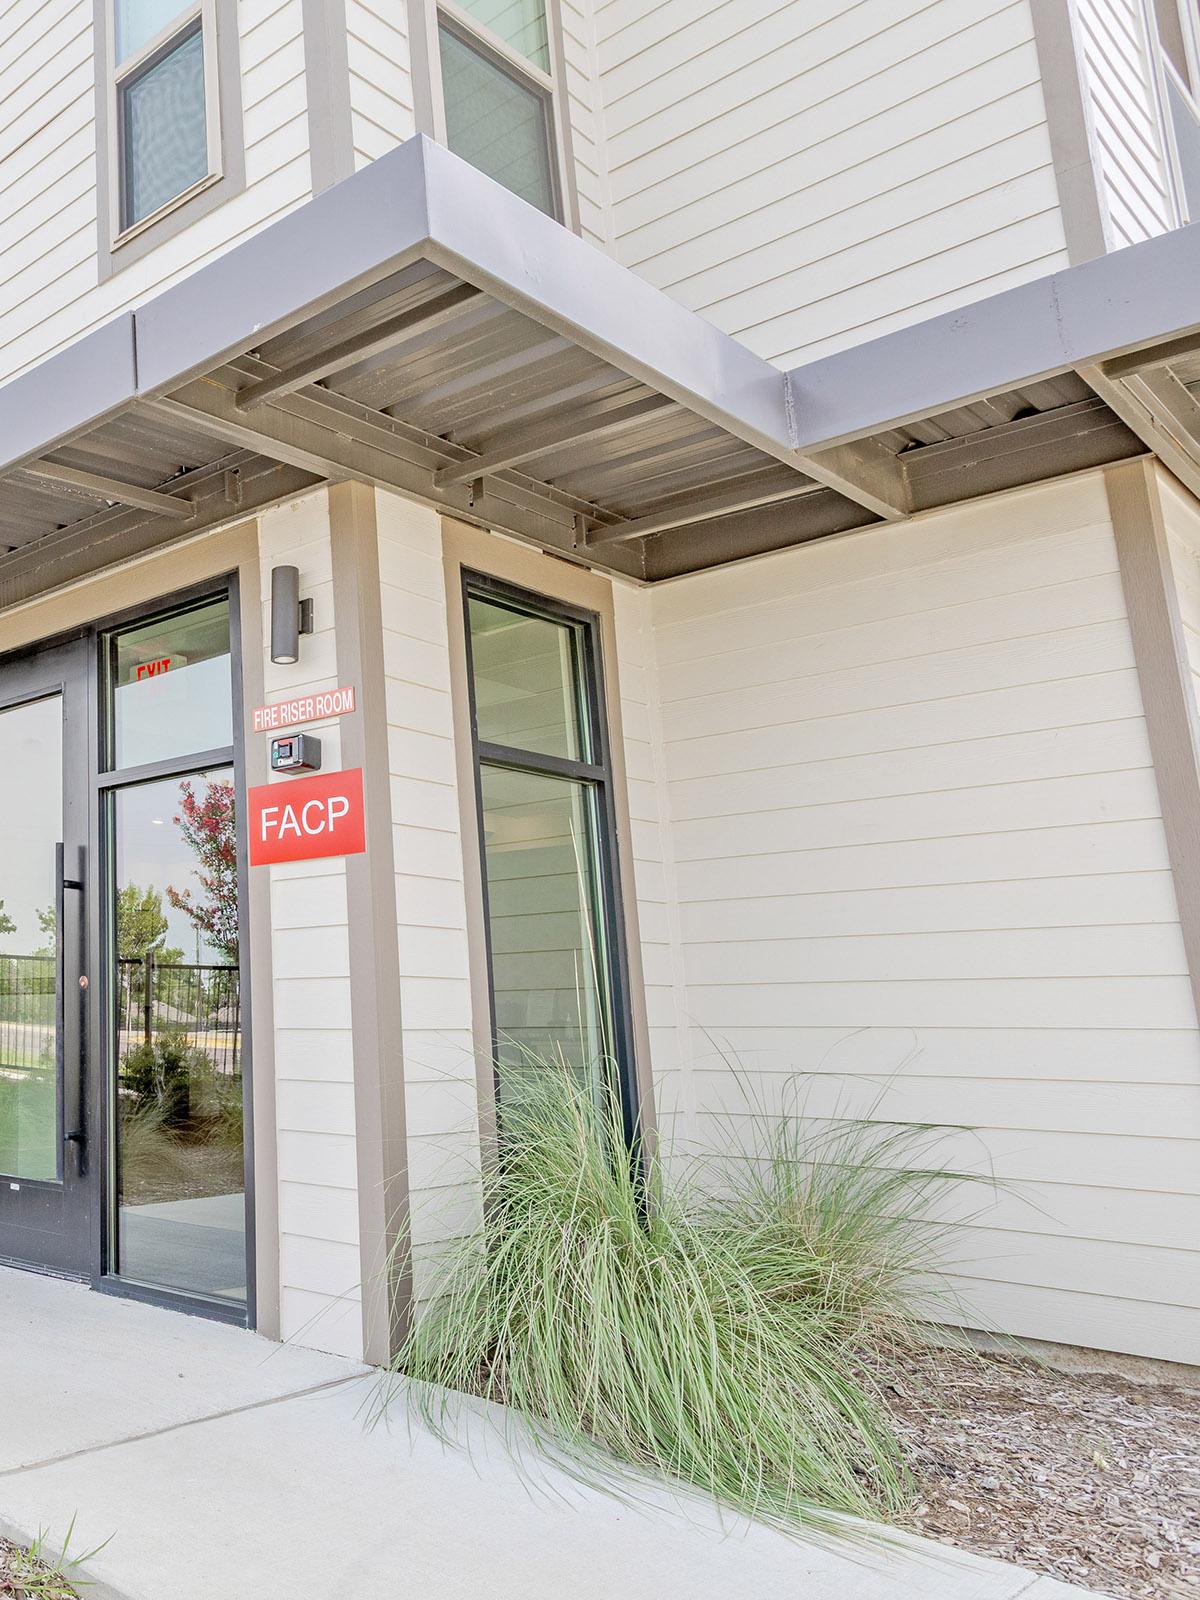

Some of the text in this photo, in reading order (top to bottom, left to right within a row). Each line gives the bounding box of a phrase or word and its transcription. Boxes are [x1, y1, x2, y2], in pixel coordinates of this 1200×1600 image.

[254, 689, 353, 730] FIRE RISER ROOM
[261, 796, 350, 841] FACP
